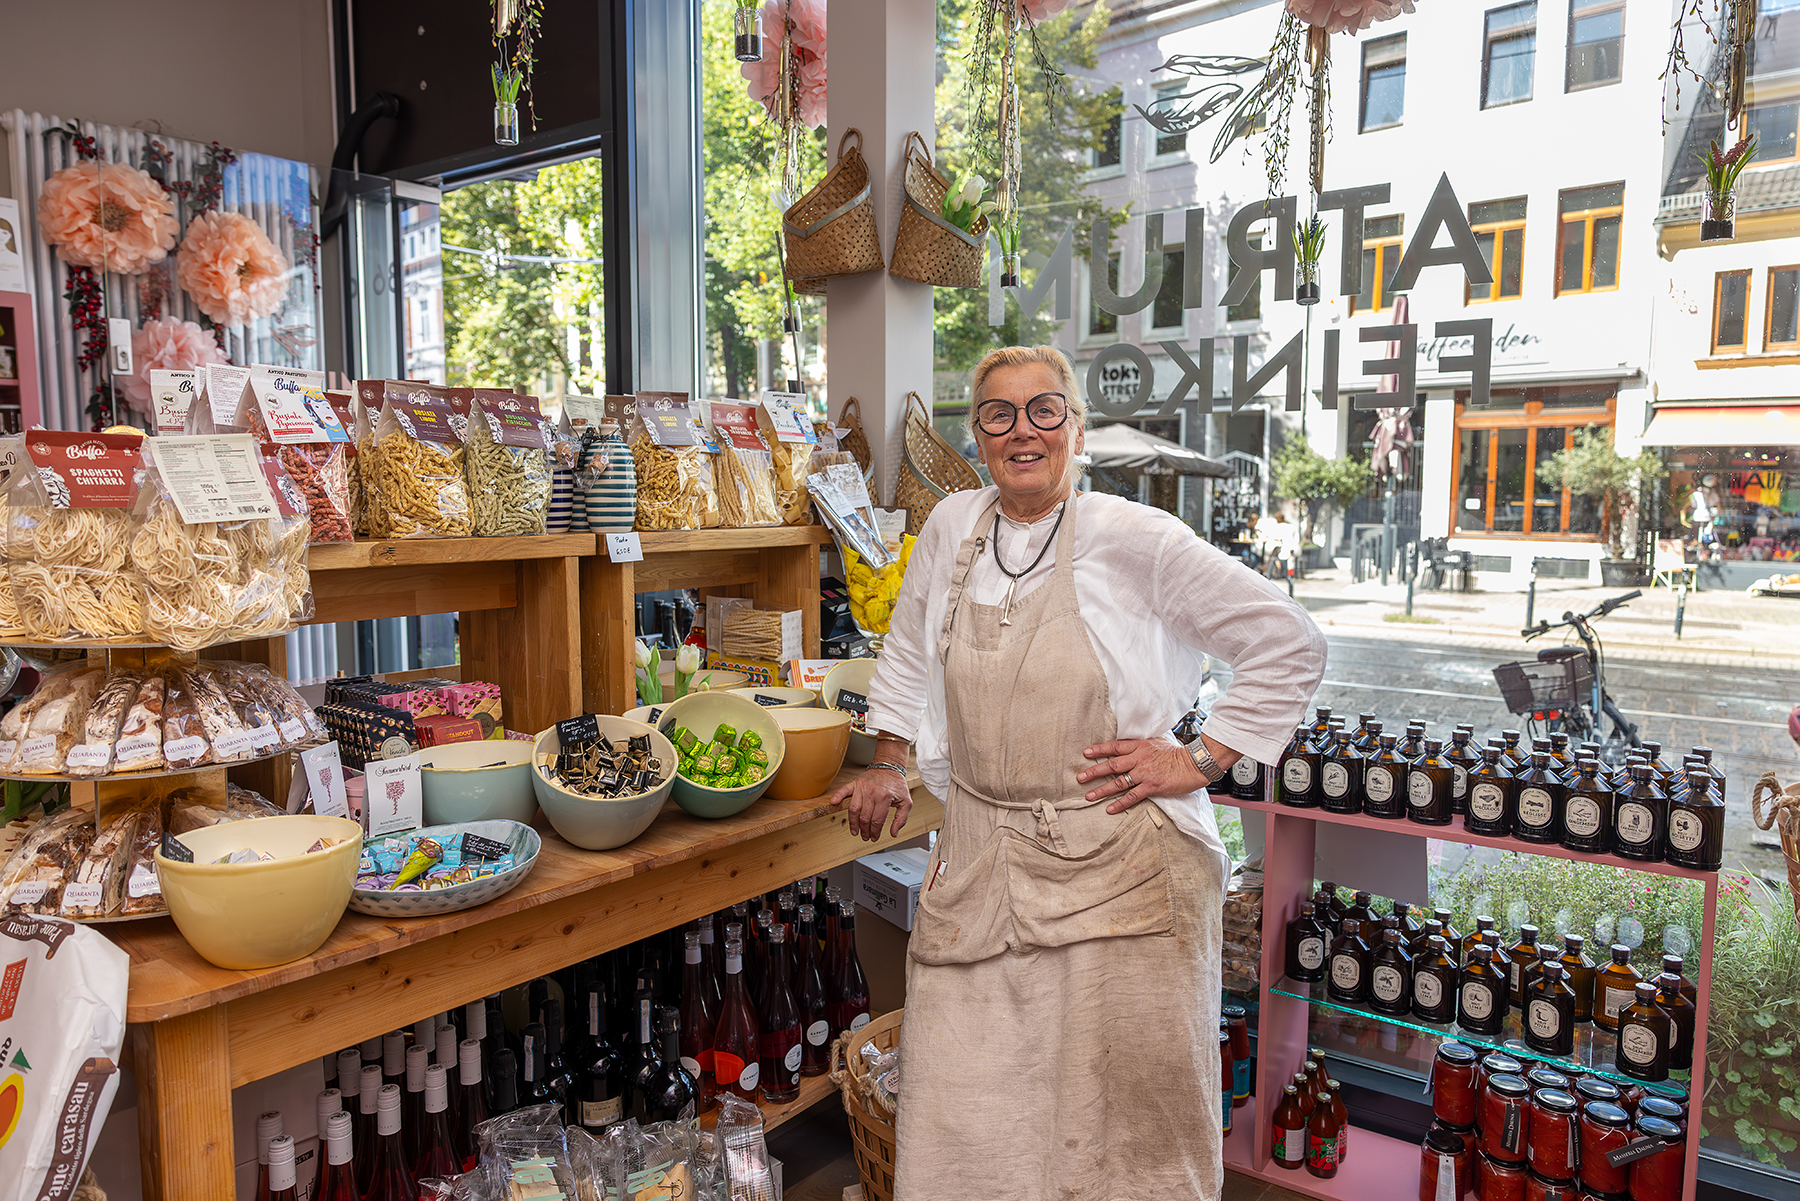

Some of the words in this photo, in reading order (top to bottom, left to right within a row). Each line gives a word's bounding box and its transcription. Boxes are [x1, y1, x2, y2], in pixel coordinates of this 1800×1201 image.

[274, 378, 301, 394] Buffa
[1102, 384, 1139, 396] STREE
[407, 391, 431, 406] Buffa
[498, 400, 521, 412] Buffa
[65, 444, 106, 460] Buffa
[69, 468, 124, 478] SPAGHETTI
[75, 477, 126, 486] CHITARRA
[251, 730, 277, 742] QUARANTA
[445, 728, 474, 739] STANDOUT
[22, 742, 55, 754] QUARANTA
[118, 742, 156, 753] QUARANTA
[166, 742, 201, 754] QUARANTA
[216, 736, 249, 750] QUARANTA
[1567, 819, 1597, 827] GINGEMBRE
[1671, 832, 1695, 841] NOISETTE
[7, 921, 39, 936] carasau
[40, 923, 63, 943] Pane
[1375, 986, 1398, 994] VERVEINE
[1534, 1022, 1551, 1030] POIRE
[1623, 1045, 1653, 1056] GINGEMBRE
[80, 1091, 95, 1124] Sardegna
[61, 1081, 89, 1155] carasau
[77, 1123, 86, 1139] della
[74, 1139, 83, 1160] tipico
[1636, 1142, 1655, 1154] DAUNA
[63, 1160, 78, 1191] Prodotto
